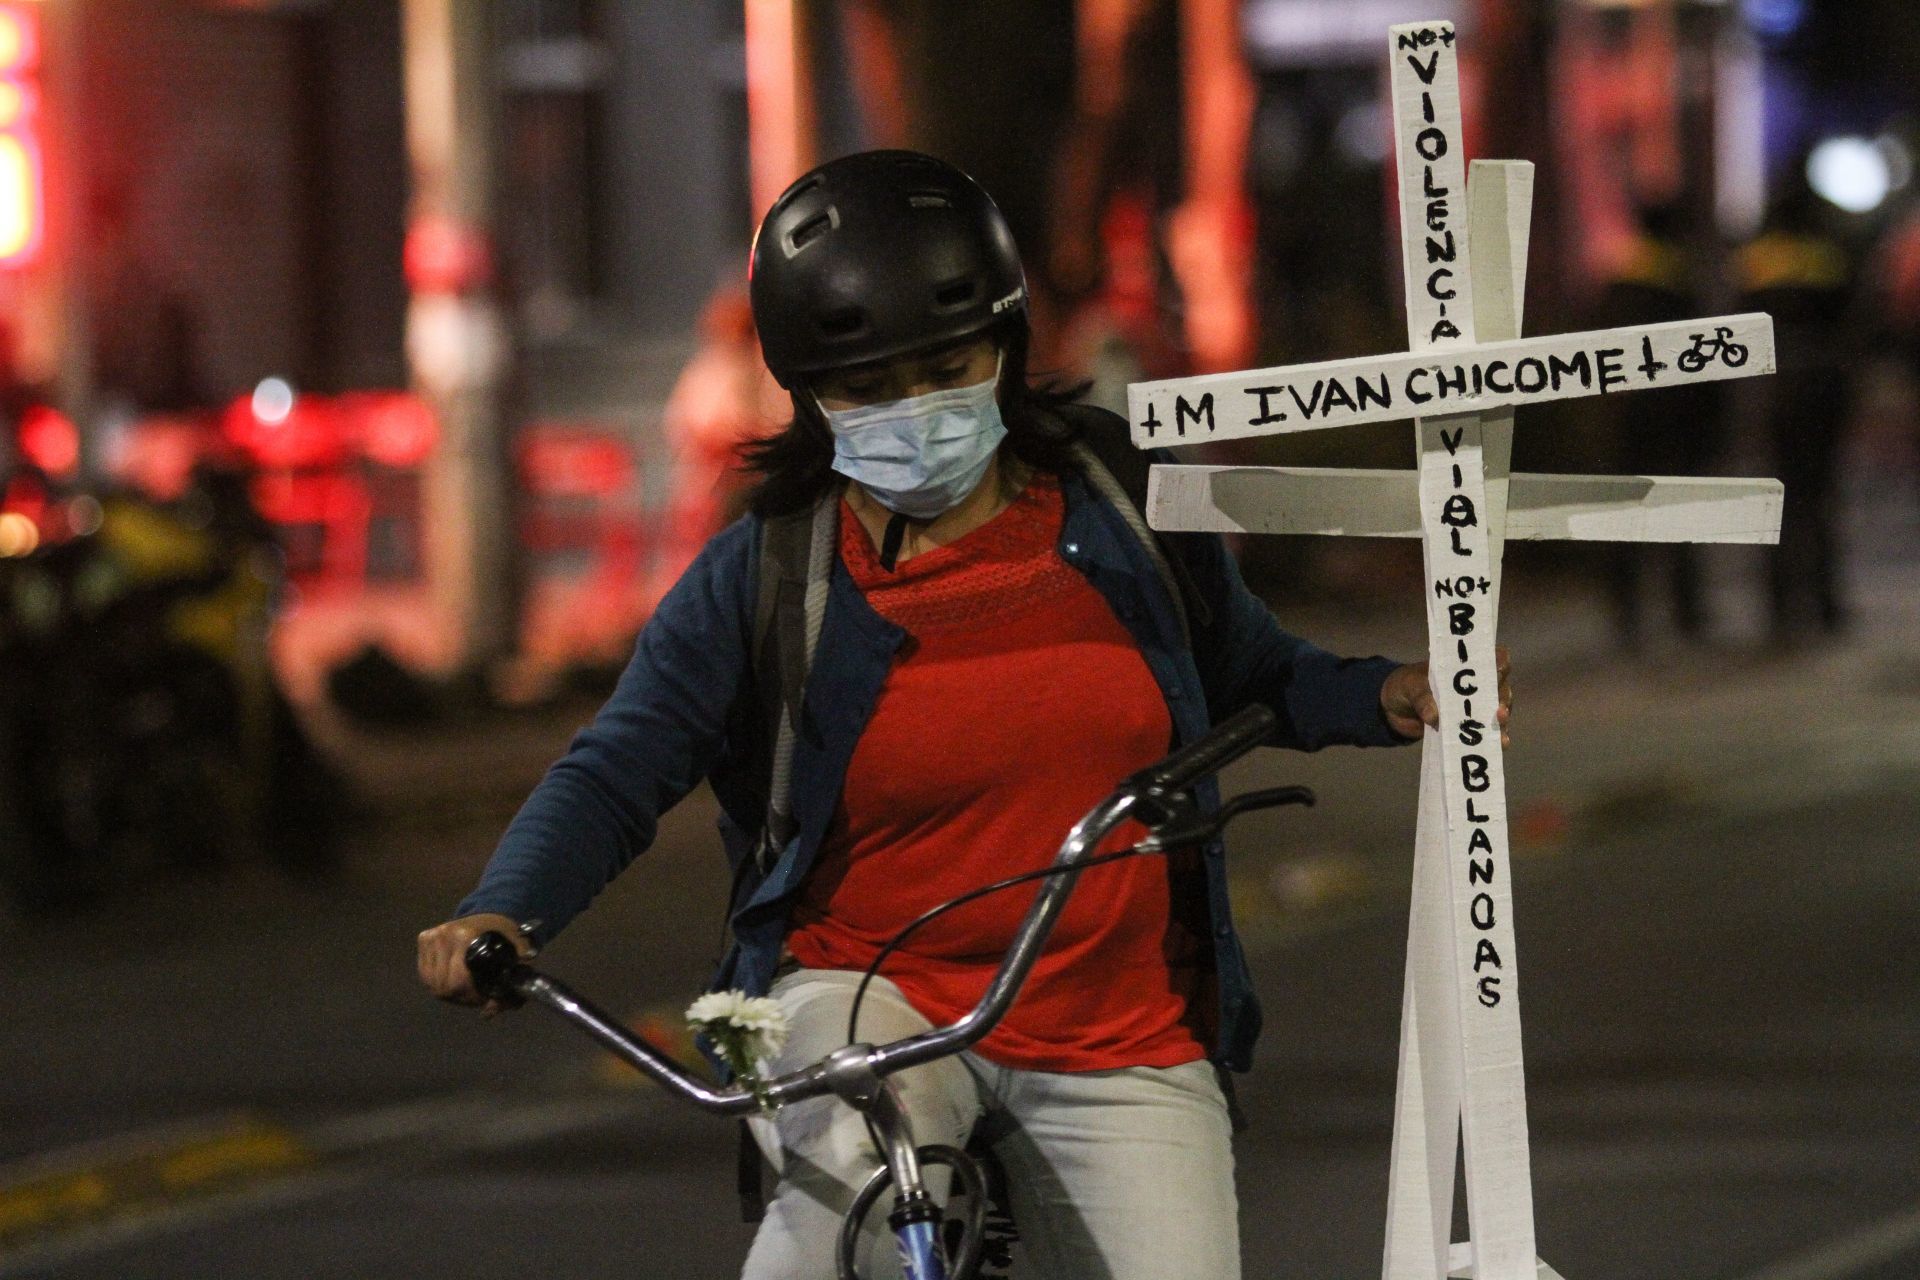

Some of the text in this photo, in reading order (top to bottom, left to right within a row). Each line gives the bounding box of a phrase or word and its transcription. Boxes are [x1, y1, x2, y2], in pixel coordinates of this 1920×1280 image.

[1407, 50, 1462, 345] VIOLENCIA
[1243, 372, 1393, 427] IVAN
[1405, 348, 1627, 404] CHICOME
[1448, 602, 1486, 747] BICIS
